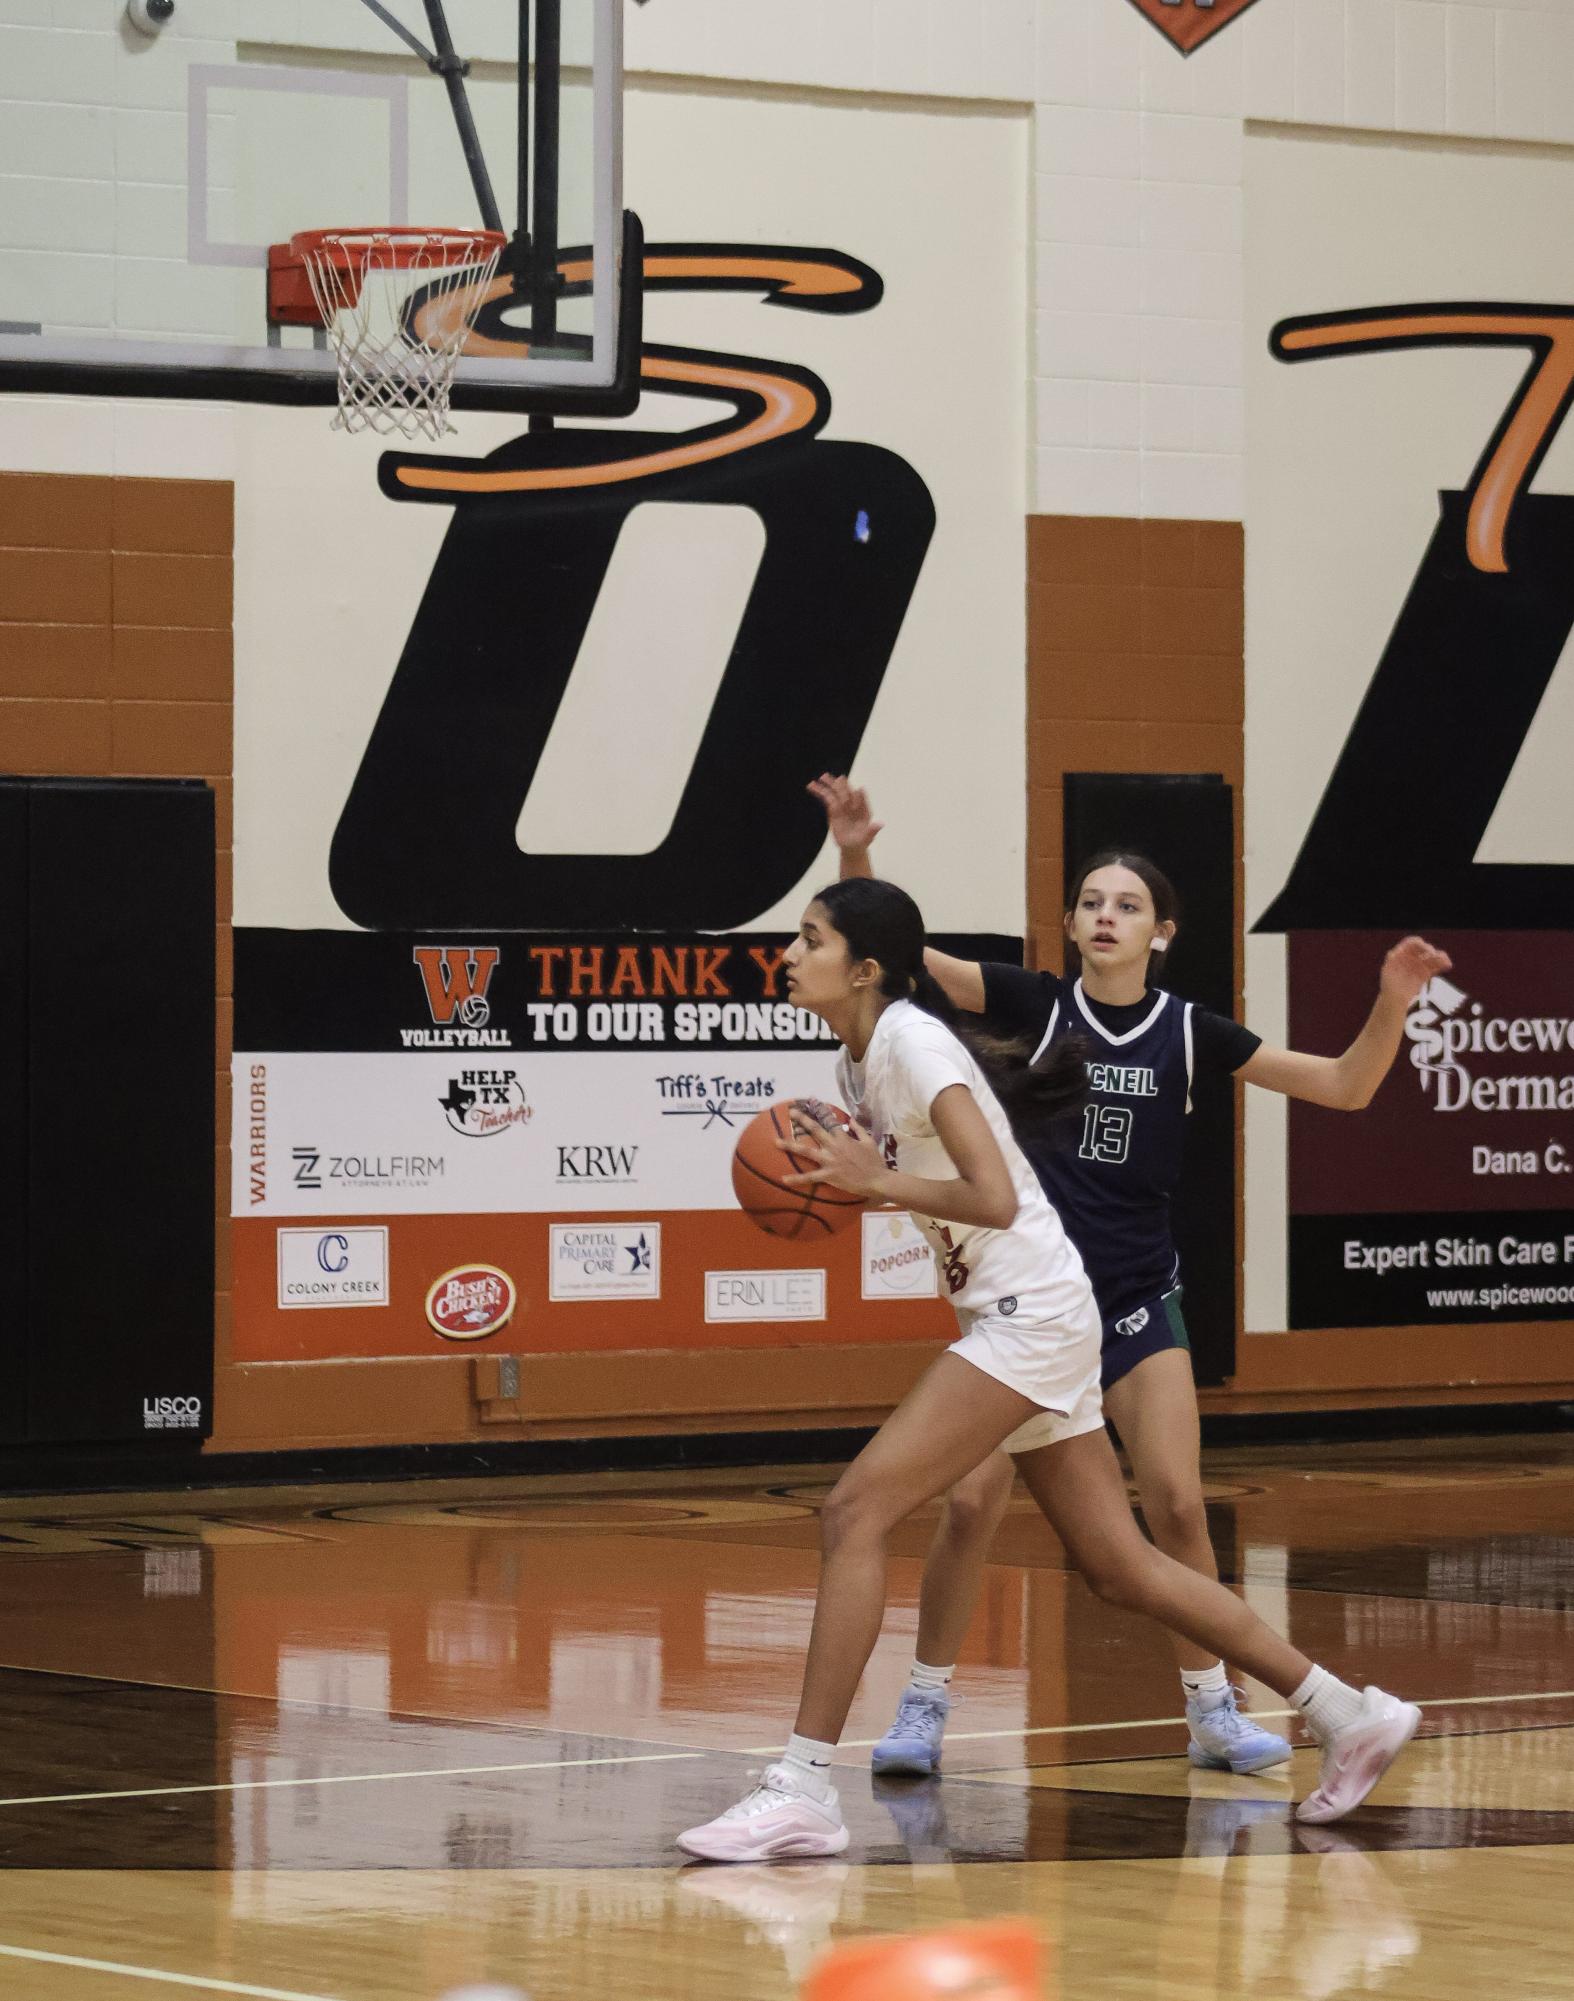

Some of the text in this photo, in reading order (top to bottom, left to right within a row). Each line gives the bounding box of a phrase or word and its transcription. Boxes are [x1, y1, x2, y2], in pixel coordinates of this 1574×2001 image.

[412, 945, 499, 1025] W
[529, 945, 732, 996] THANK
[527, 1002, 578, 1041] TO
[587, 1002, 666, 1041] OUR
[400, 1029, 512, 1047] VOLLEYBALL
[461, 1070, 516, 1086] HELP
[655, 1074, 775, 1098] Tiff's Treats
[1083, 1061, 1159, 1096] CNEIL
[480, 1087, 510, 1105] TX
[250, 1064, 266, 1206] WARRIORS
[1078, 1103, 1133, 1164] 13
[329, 1156, 445, 1178] ZOLLFIRM
[556, 1145, 639, 1177] KRW
[1472, 1143, 1573, 1175] Dana C.
[317, 1234, 349, 1272] C
[560, 1246, 616, 1261] PRIMARY
[563, 1232, 616, 1247] CAPITAL
[583, 1259, 614, 1274] CARE
[870, 1243, 930, 1275] POPCORN
[1343, 1239, 1429, 1276] Expert
[1434, 1237, 1493, 1267] Skin
[1498, 1236, 1557, 1266] Care
[287, 1281, 379, 1295] COLONY CREEK
[717, 1280, 764, 1306] ERIN
[143, 1396, 202, 1415] LISCO
